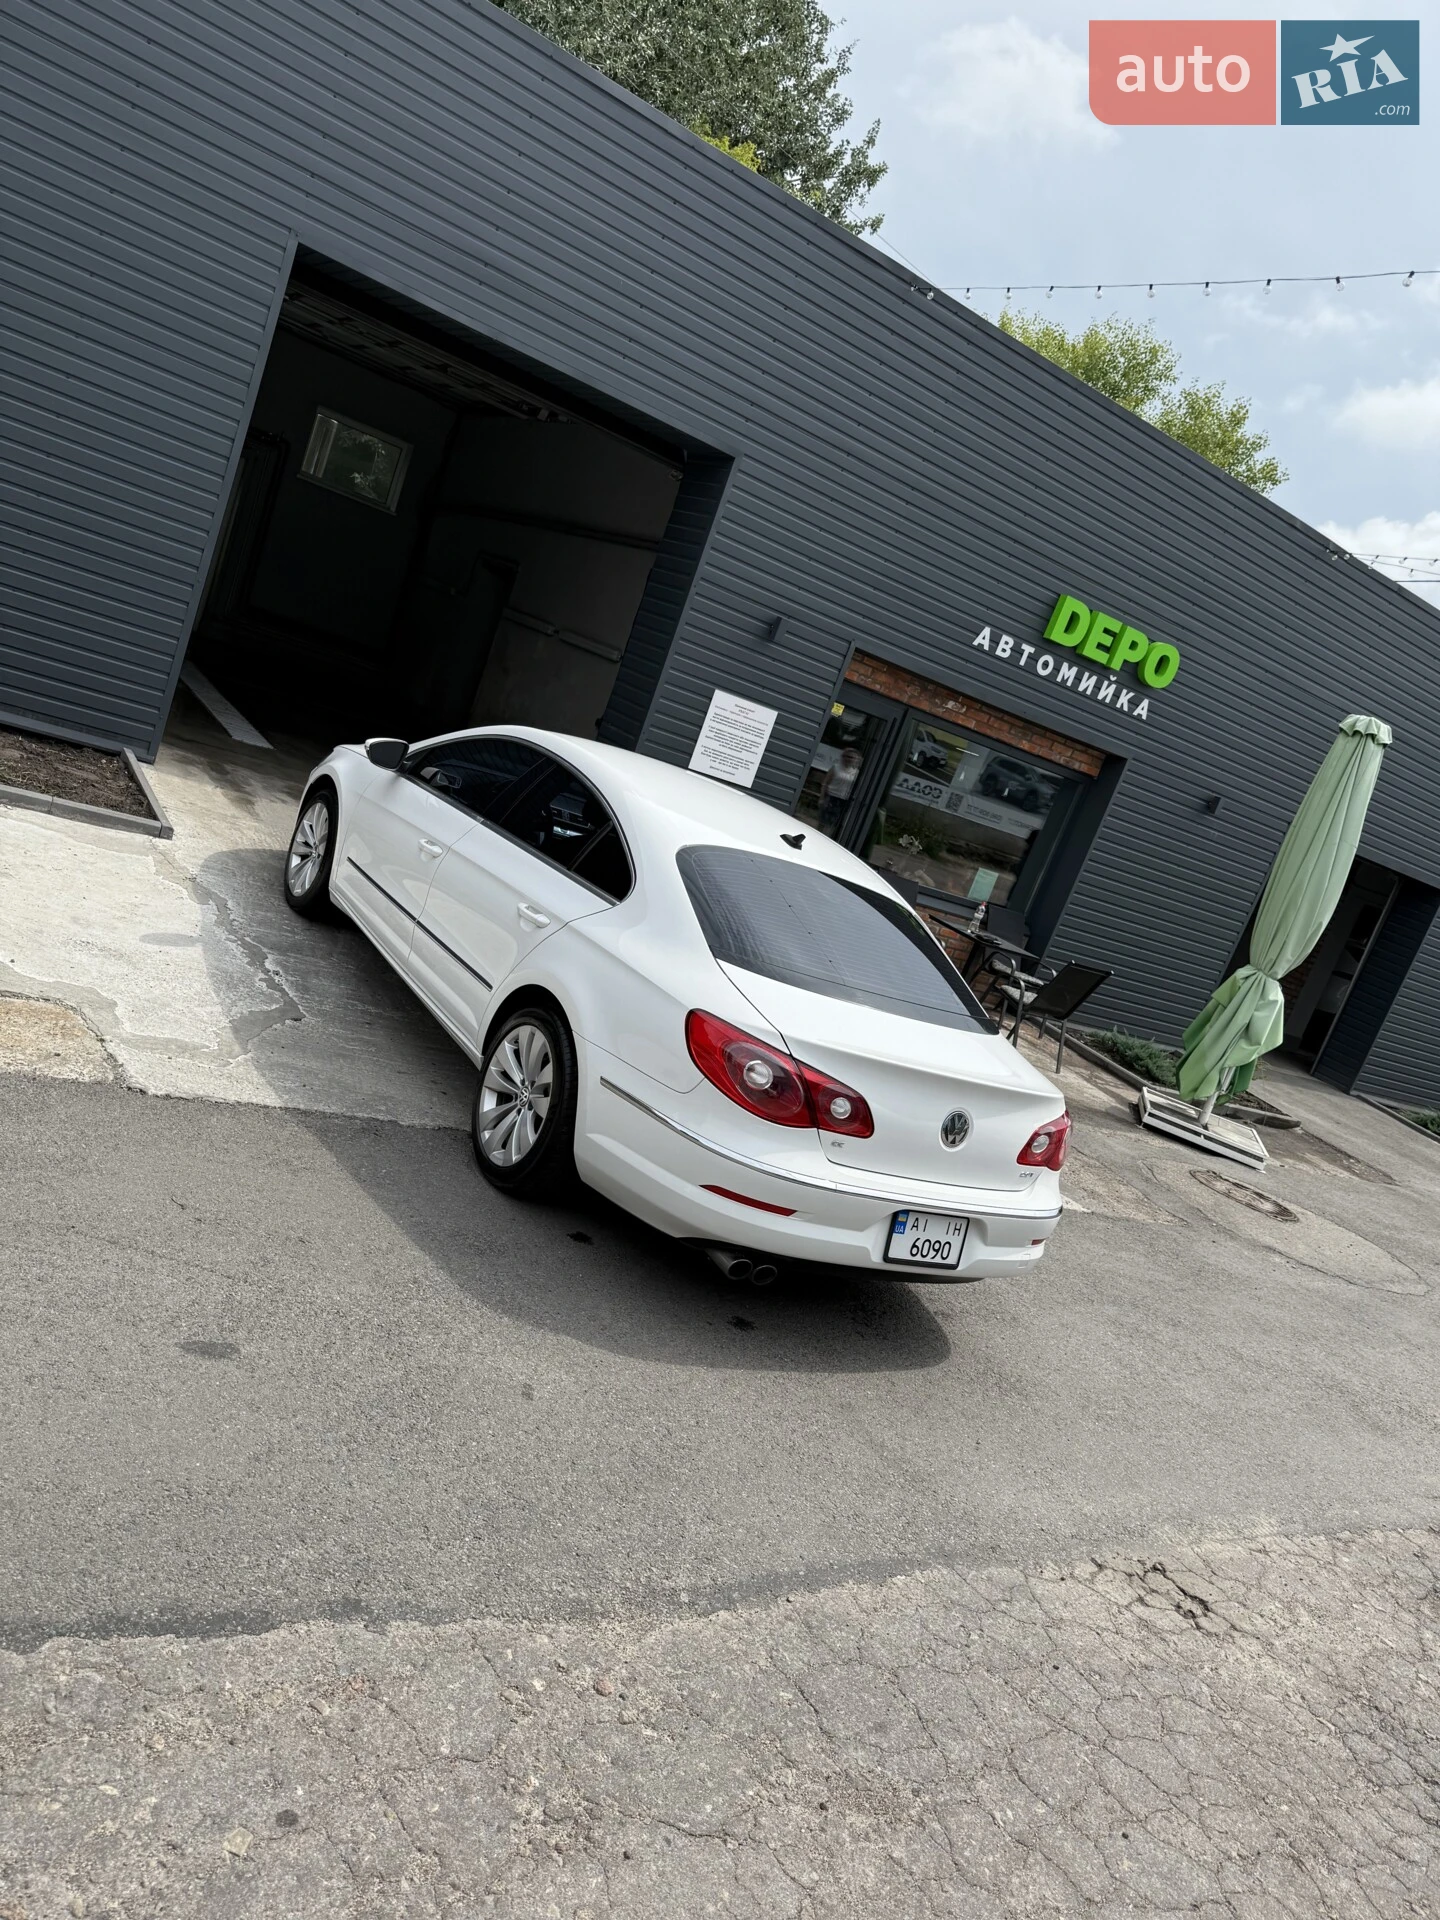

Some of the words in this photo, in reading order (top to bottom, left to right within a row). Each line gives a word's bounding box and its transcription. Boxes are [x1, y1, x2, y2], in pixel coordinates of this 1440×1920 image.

[1043, 593, 1181, 689] DEPO
[972, 626, 1151, 720] АВТОМИЙКА
[895, 1225, 904, 1233] UA
[910, 1217, 928, 1232] AI
[946, 1221, 963, 1237] IH
[910, 1237, 952, 1260] 6090
